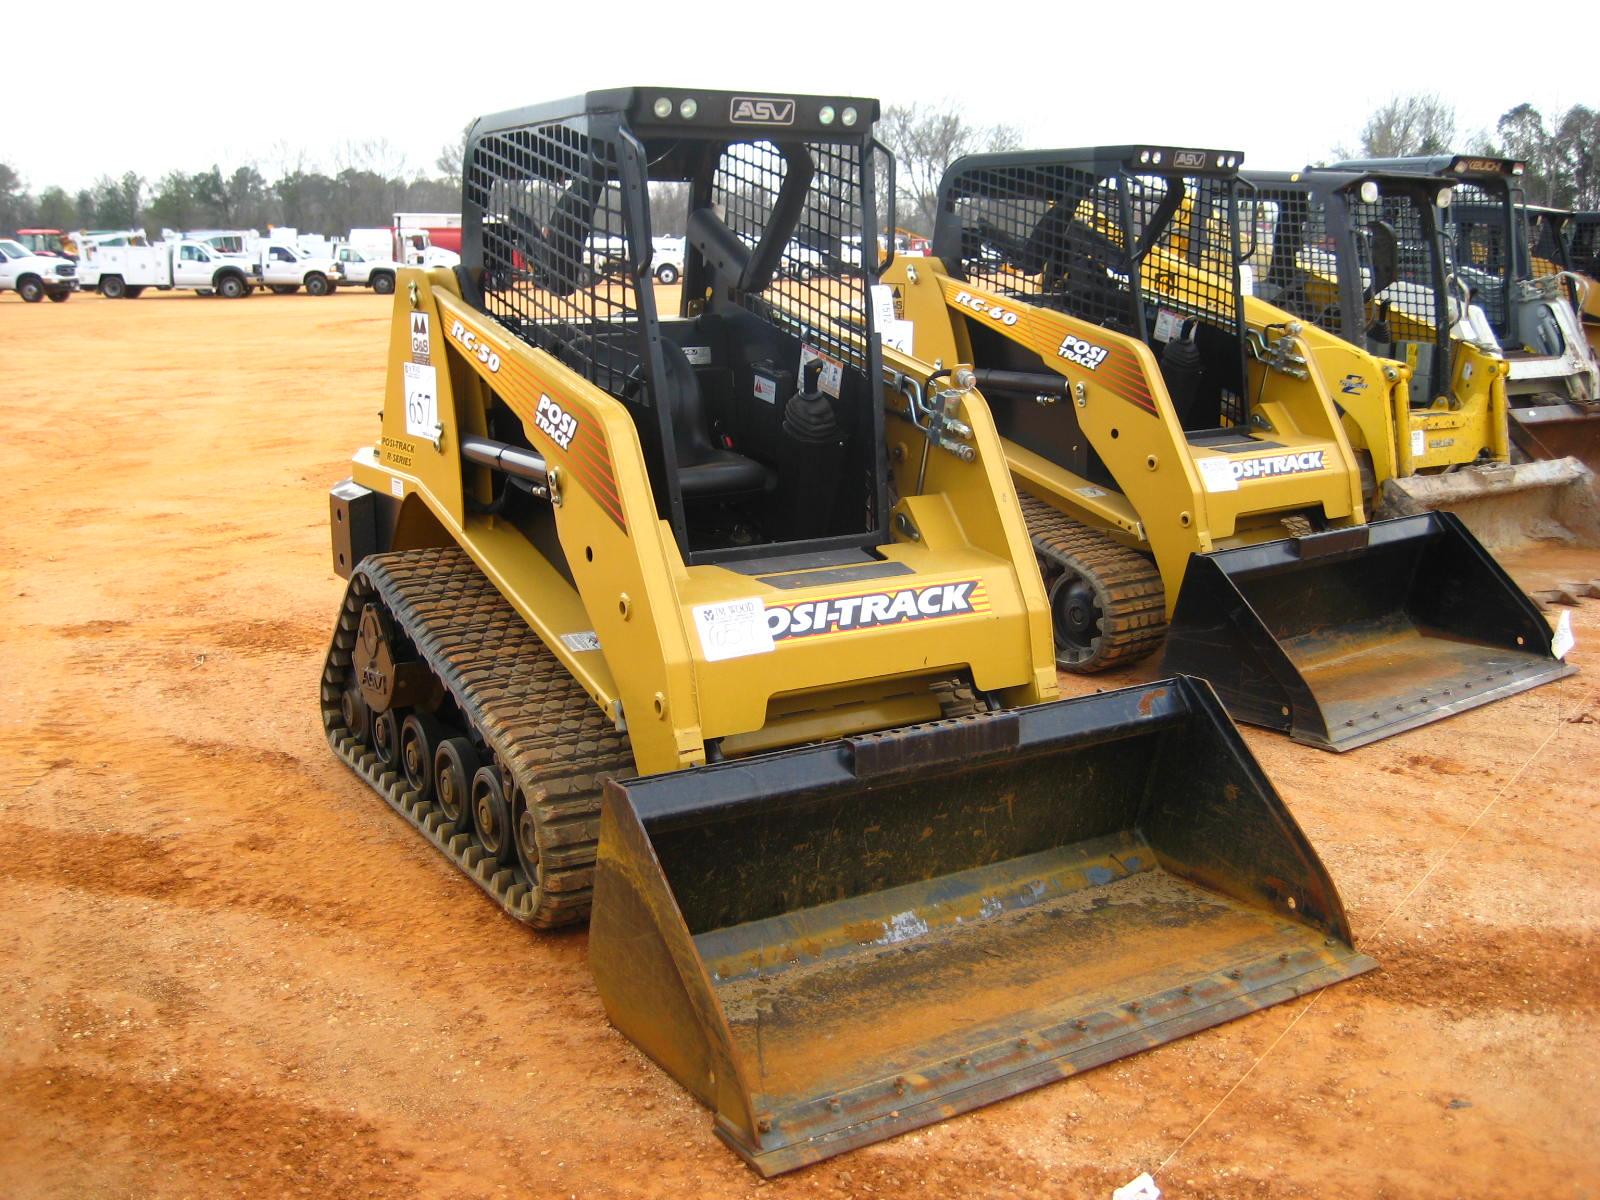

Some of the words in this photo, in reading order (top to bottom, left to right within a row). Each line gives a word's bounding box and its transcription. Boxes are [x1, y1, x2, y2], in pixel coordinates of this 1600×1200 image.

[734, 101, 792, 121] ASV
[1176, 153, 1204, 166] ASV
[1057, 345, 1101, 371] TRACK
[1060, 334, 1109, 363] POSI
[408, 391, 432, 428] 657
[537, 392, 578, 441] POSI
[535, 410, 571, 452] TRACK
[1230, 451, 1324, 480] OSI-TRACK
[764, 582, 977, 639] OSI-TRACK
